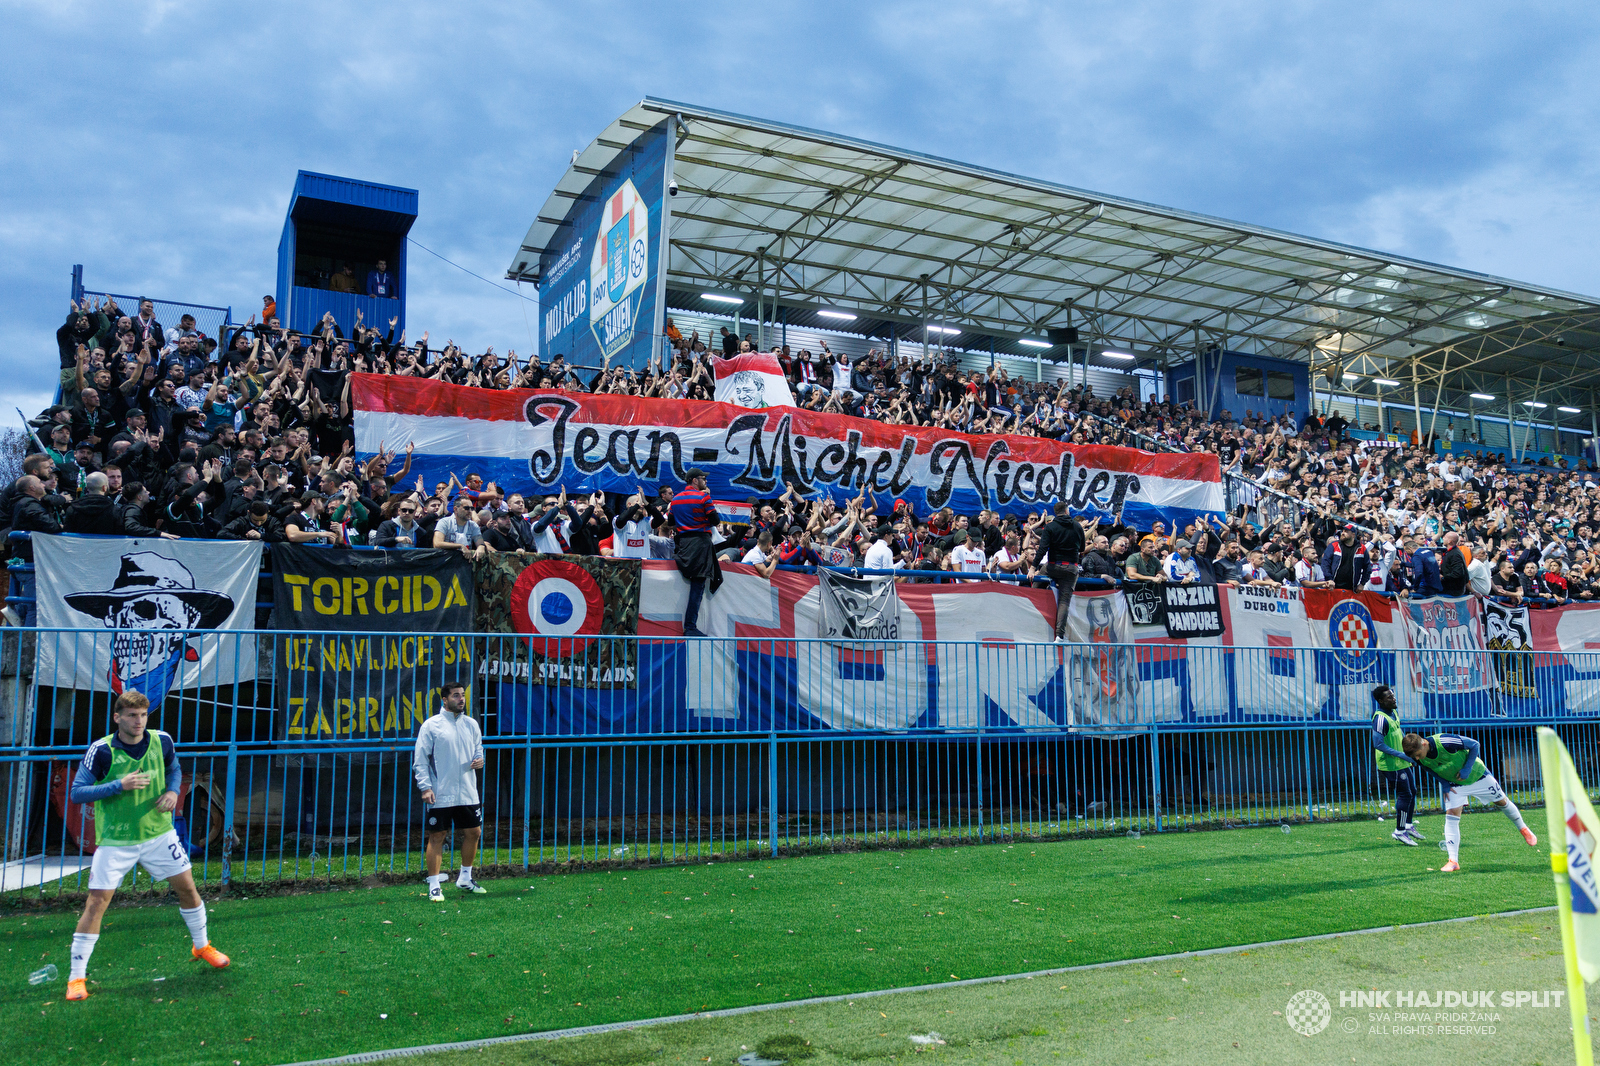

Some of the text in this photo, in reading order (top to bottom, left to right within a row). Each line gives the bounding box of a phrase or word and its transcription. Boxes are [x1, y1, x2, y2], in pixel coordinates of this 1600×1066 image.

[545, 279, 587, 345] MOJ KLUB
[605, 295, 631, 345] SLAVEN
[926, 439, 1141, 515] Nicolier
[284, 572, 468, 616] TORCIDA
[1165, 585, 1216, 607] MRZIN
[1244, 600, 1290, 614] DUHOM
[1168, 611, 1220, 631] PANDURE
[285, 637, 315, 672] UZ
[442, 635, 471, 665] SA
[538, 663, 586, 681] SPLIT
[591, 666, 635, 682] LADS
[1429, 674, 1473, 686] SPLIT
